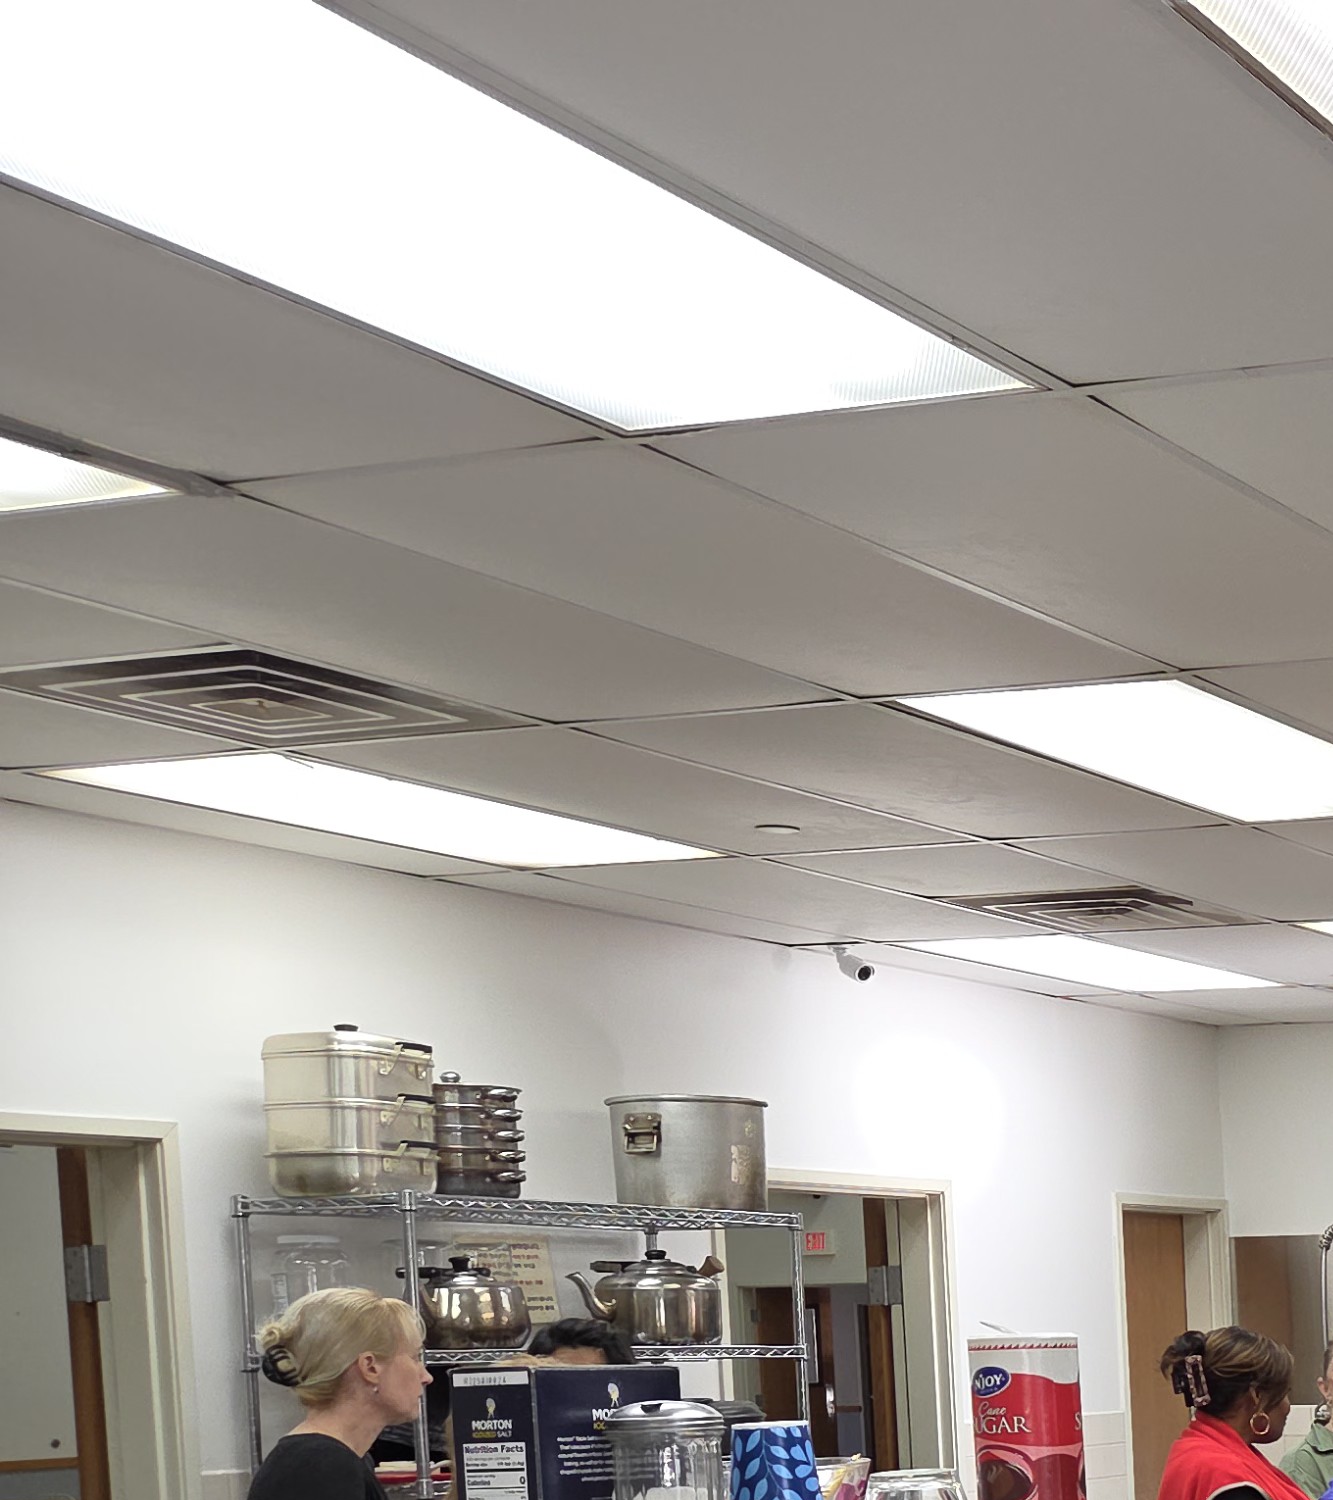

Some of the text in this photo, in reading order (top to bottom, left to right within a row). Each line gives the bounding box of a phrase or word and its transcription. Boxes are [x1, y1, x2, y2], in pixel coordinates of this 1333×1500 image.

[978, 1401, 1006, 1418] Cane
[471, 1419, 513, 1431] MORTON
[974, 1415, 1032, 1434] UGAR
[497, 1430, 513, 1438] SALT
[500, 1444, 524, 1453] Facts
